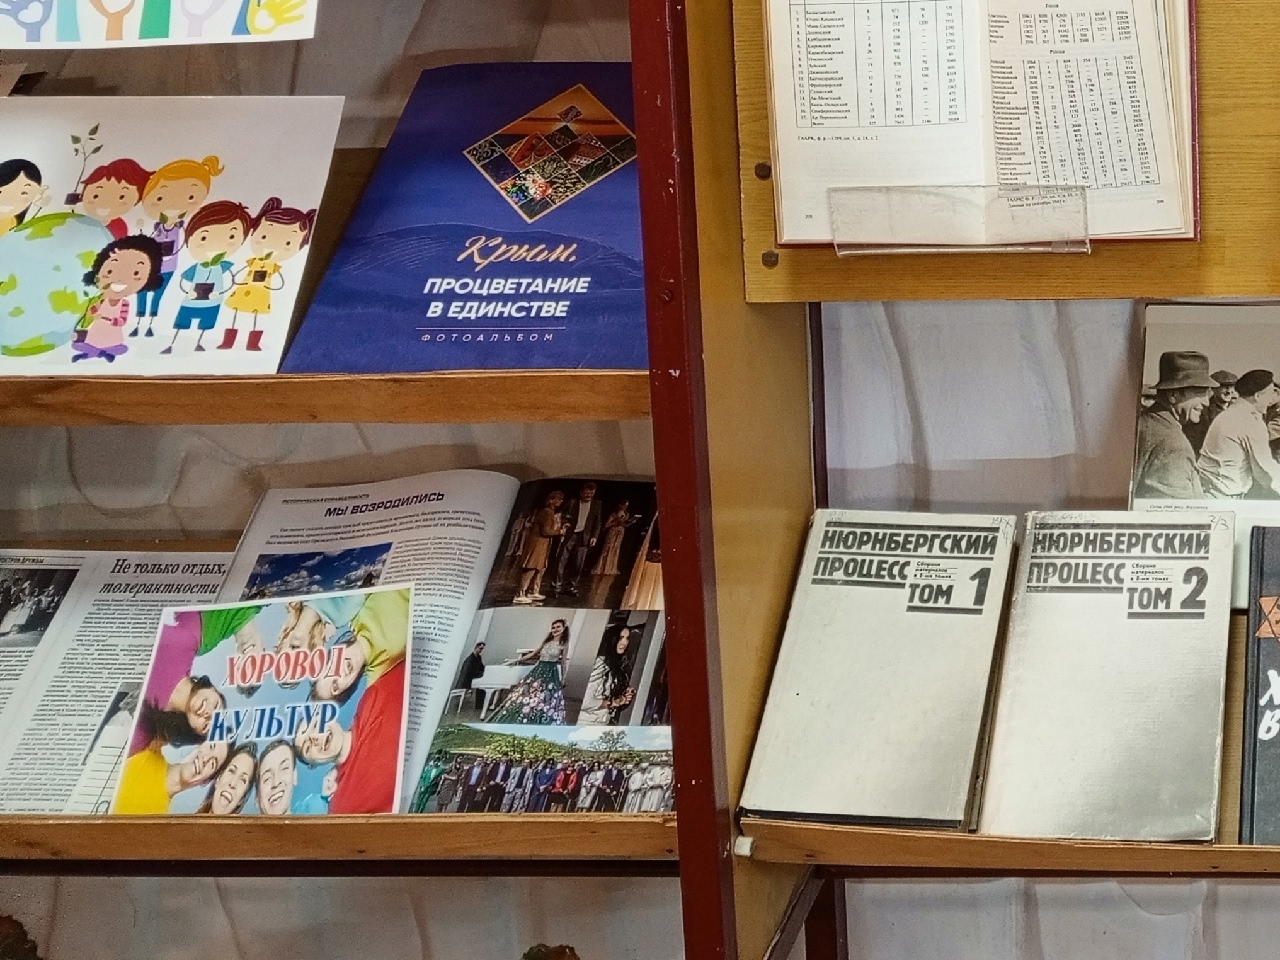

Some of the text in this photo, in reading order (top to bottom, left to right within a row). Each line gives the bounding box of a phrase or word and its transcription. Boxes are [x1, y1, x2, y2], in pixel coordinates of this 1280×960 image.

[457, 236, 578, 273] Крым.
[423, 277, 592, 296] ПРОЦВЕТАНИЕ
[426, 301, 570, 320] В ЕДИНСТВЕ
[421, 333, 553, 342] ФОТОАЛЬБОМ
[324, 492, 445, 517] МЫ ВОЗРОДИЛИСЬ
[820, 529, 998, 555] НЮРНБЕРГСКИЙ
[1031, 530, 1211, 556] НЮРНБЕРГСКИЙ
[110, 559, 226, 576] Не только отдых,
[812, 556, 911, 581] ПРОЦЕСС
[1027, 561, 1126, 585] ПРОЦЕСС
[99, 580, 220, 598] толерантности
[907, 567, 992, 607] ТОМ 1
[1126, 566, 1209, 610] ТОМ 2
[222, 647, 346, 686] ХОРОВОД
[209, 704, 337, 742] КУЛЬТУР
